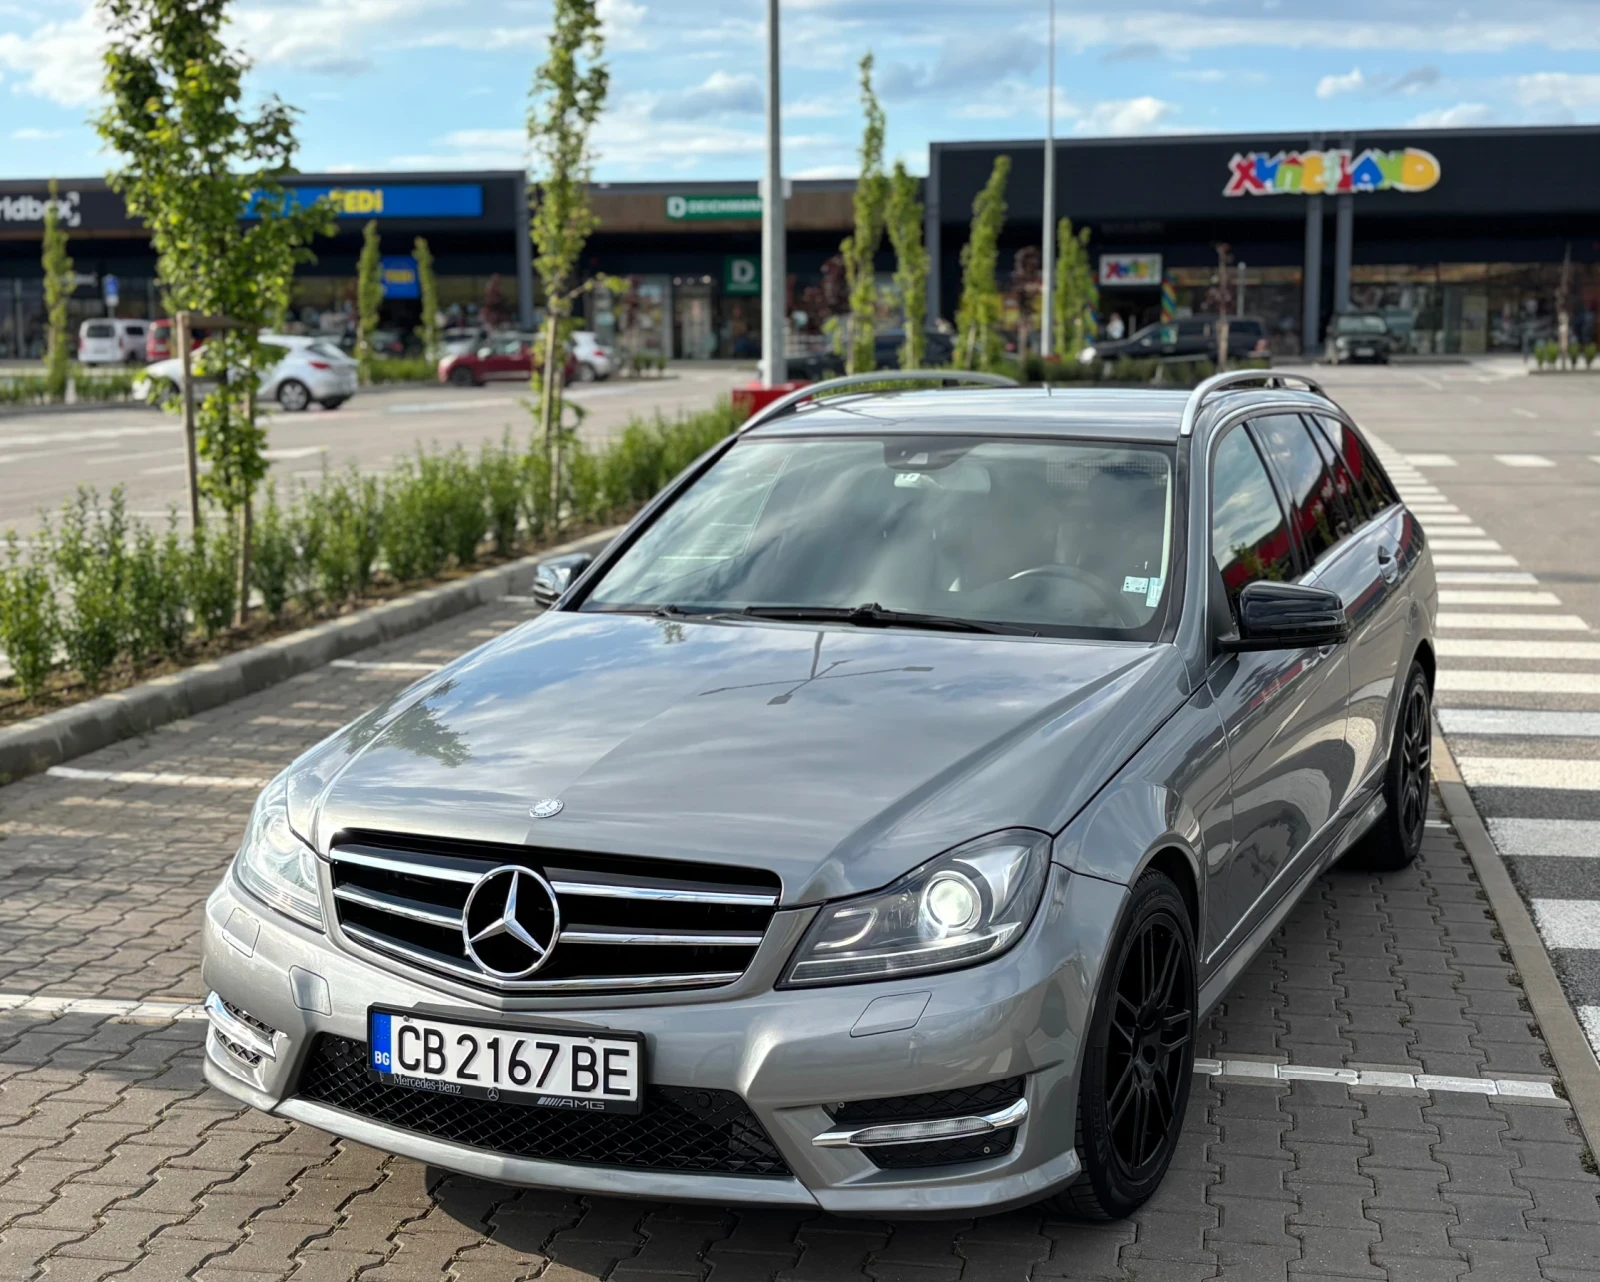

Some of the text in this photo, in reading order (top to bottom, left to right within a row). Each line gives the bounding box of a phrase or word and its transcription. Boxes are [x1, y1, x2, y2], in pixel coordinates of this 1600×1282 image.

[731, 259, 756, 284] D
[374, 1050, 390, 1066] BG
[397, 1024, 631, 1096] CB 2167 BE
[393, 1073, 461, 1094] Mercedes-Benz
[559, 1097, 605, 1110] AMG
